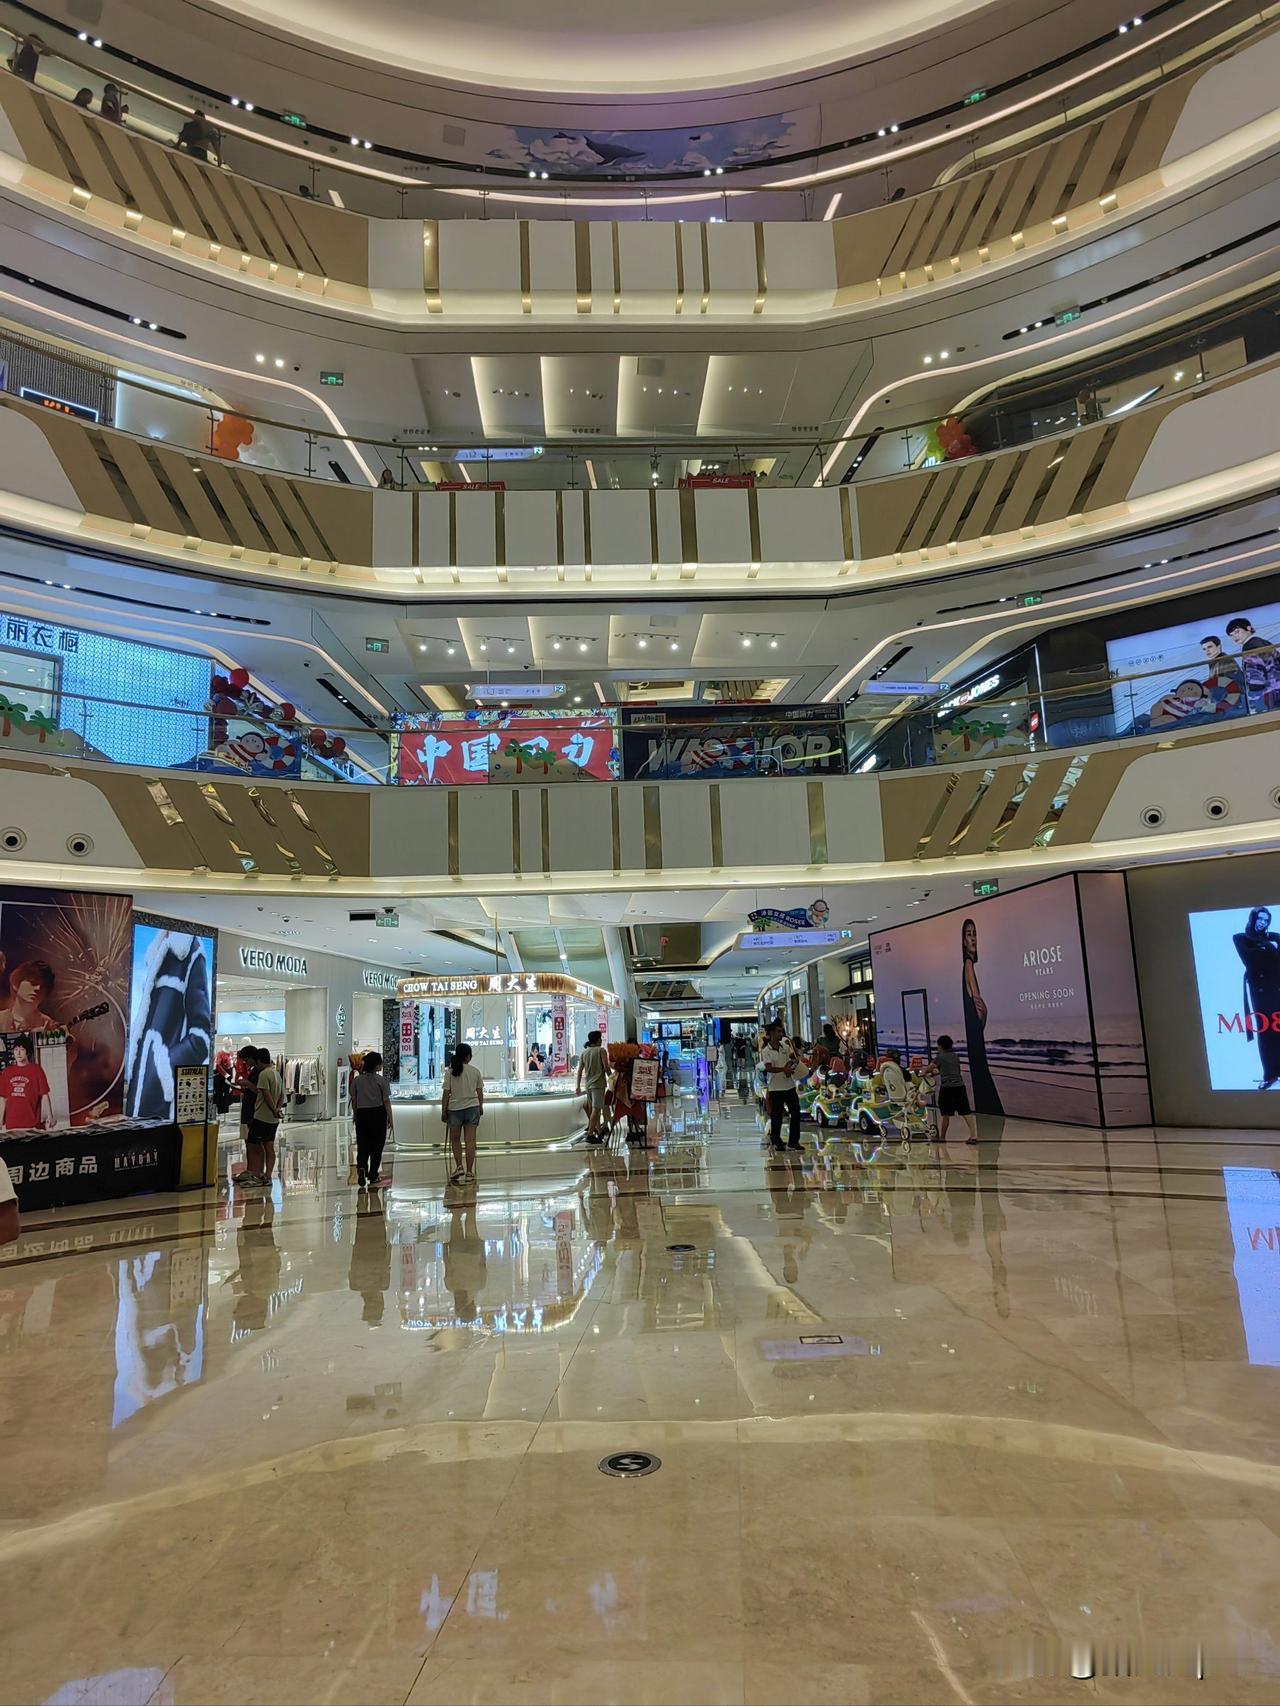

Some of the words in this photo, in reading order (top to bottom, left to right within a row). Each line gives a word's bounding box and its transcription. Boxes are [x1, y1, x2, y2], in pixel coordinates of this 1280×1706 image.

[841, 930, 852, 938] F1
[240, 947, 274, 970] VERO
[274, 953, 308, 976] MODA
[1023, 945, 1062, 967] ARIOSE
[362, 969, 383, 988] VERO
[403, 982, 429, 993] CHOW
[430, 981, 449, 992] TAI
[449, 980, 478, 991] SENG
[488, 974, 537, 993] 周大生
[1019, 989, 1051, 1002] OPENING
[1052, 988, 1075, 999] SOON
[7, 1155, 99, 1185] 周边商品
